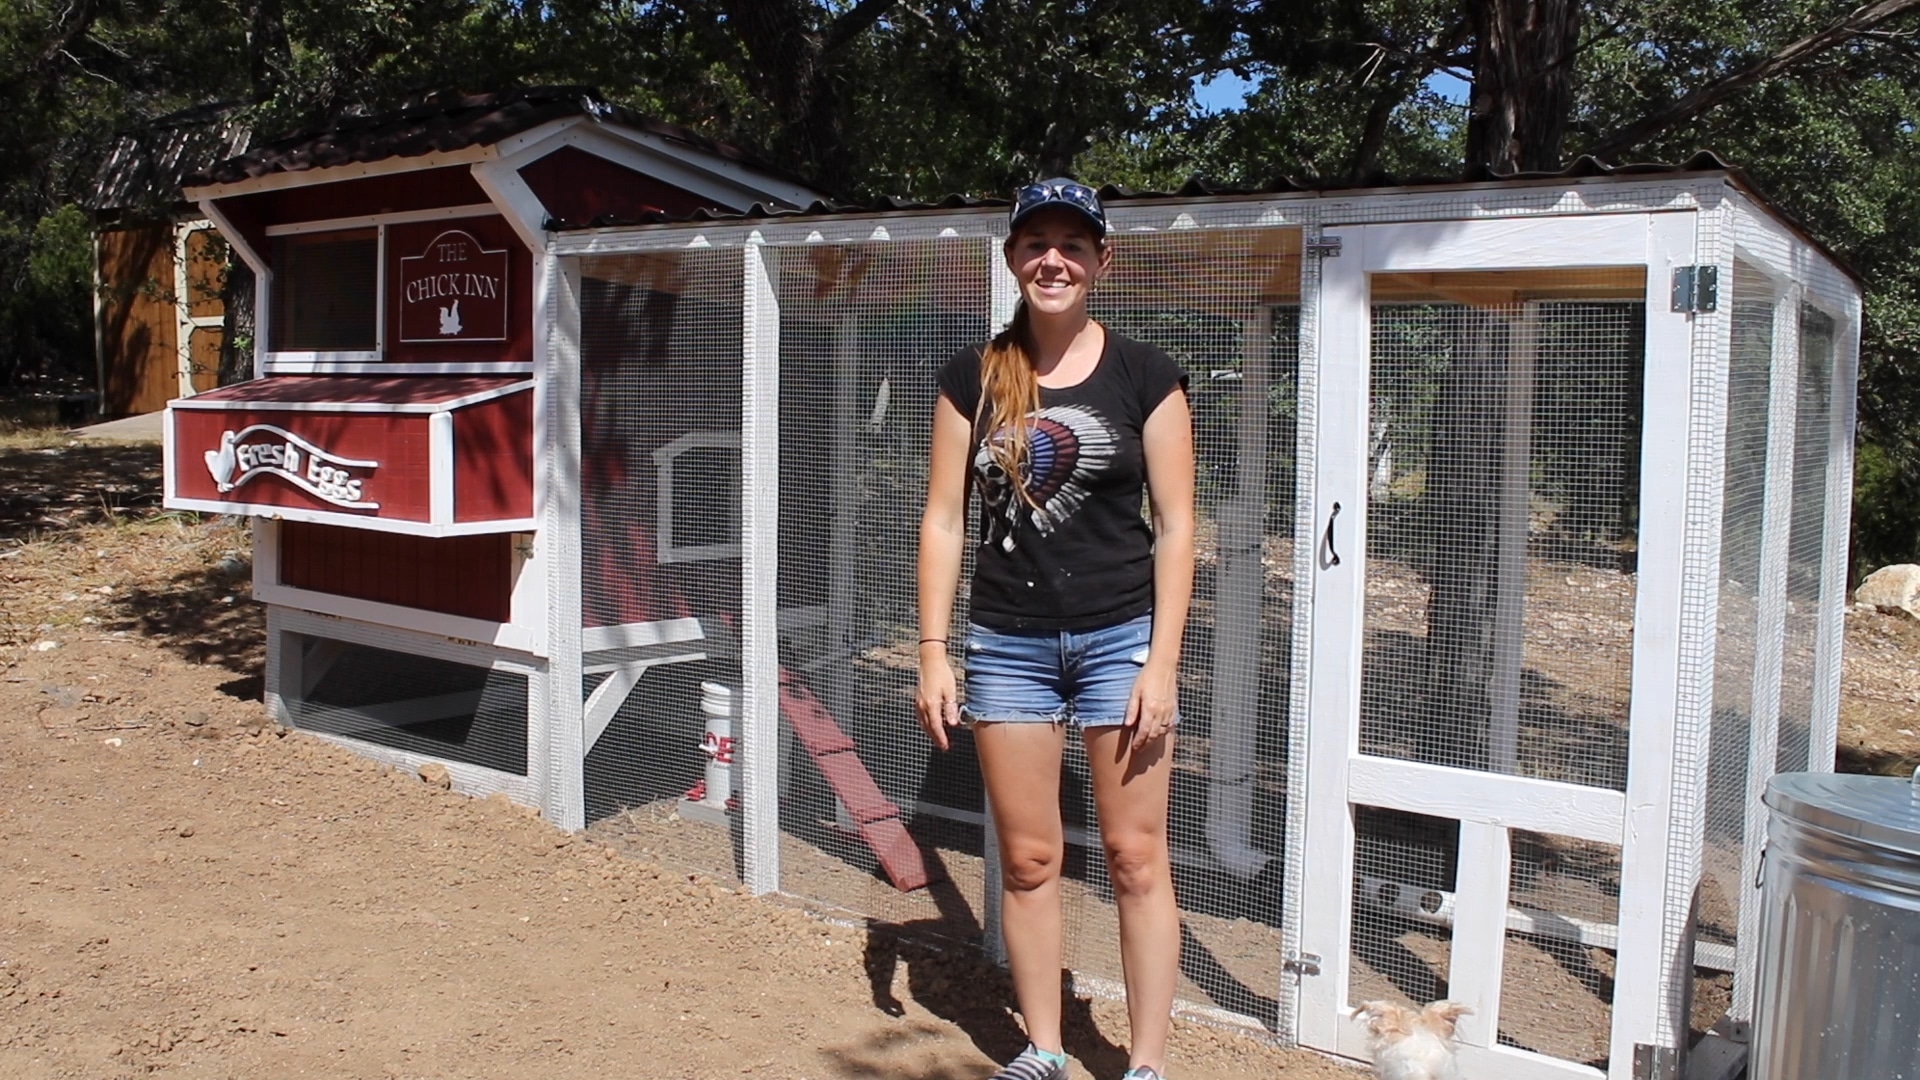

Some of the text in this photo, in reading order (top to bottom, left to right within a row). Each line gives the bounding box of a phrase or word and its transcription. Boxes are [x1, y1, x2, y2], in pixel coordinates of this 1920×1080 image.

[437, 242, 467, 262] THE
[406, 273, 499, 303] CHICK INN
[236, 442, 362, 501] Fresh Eggs
